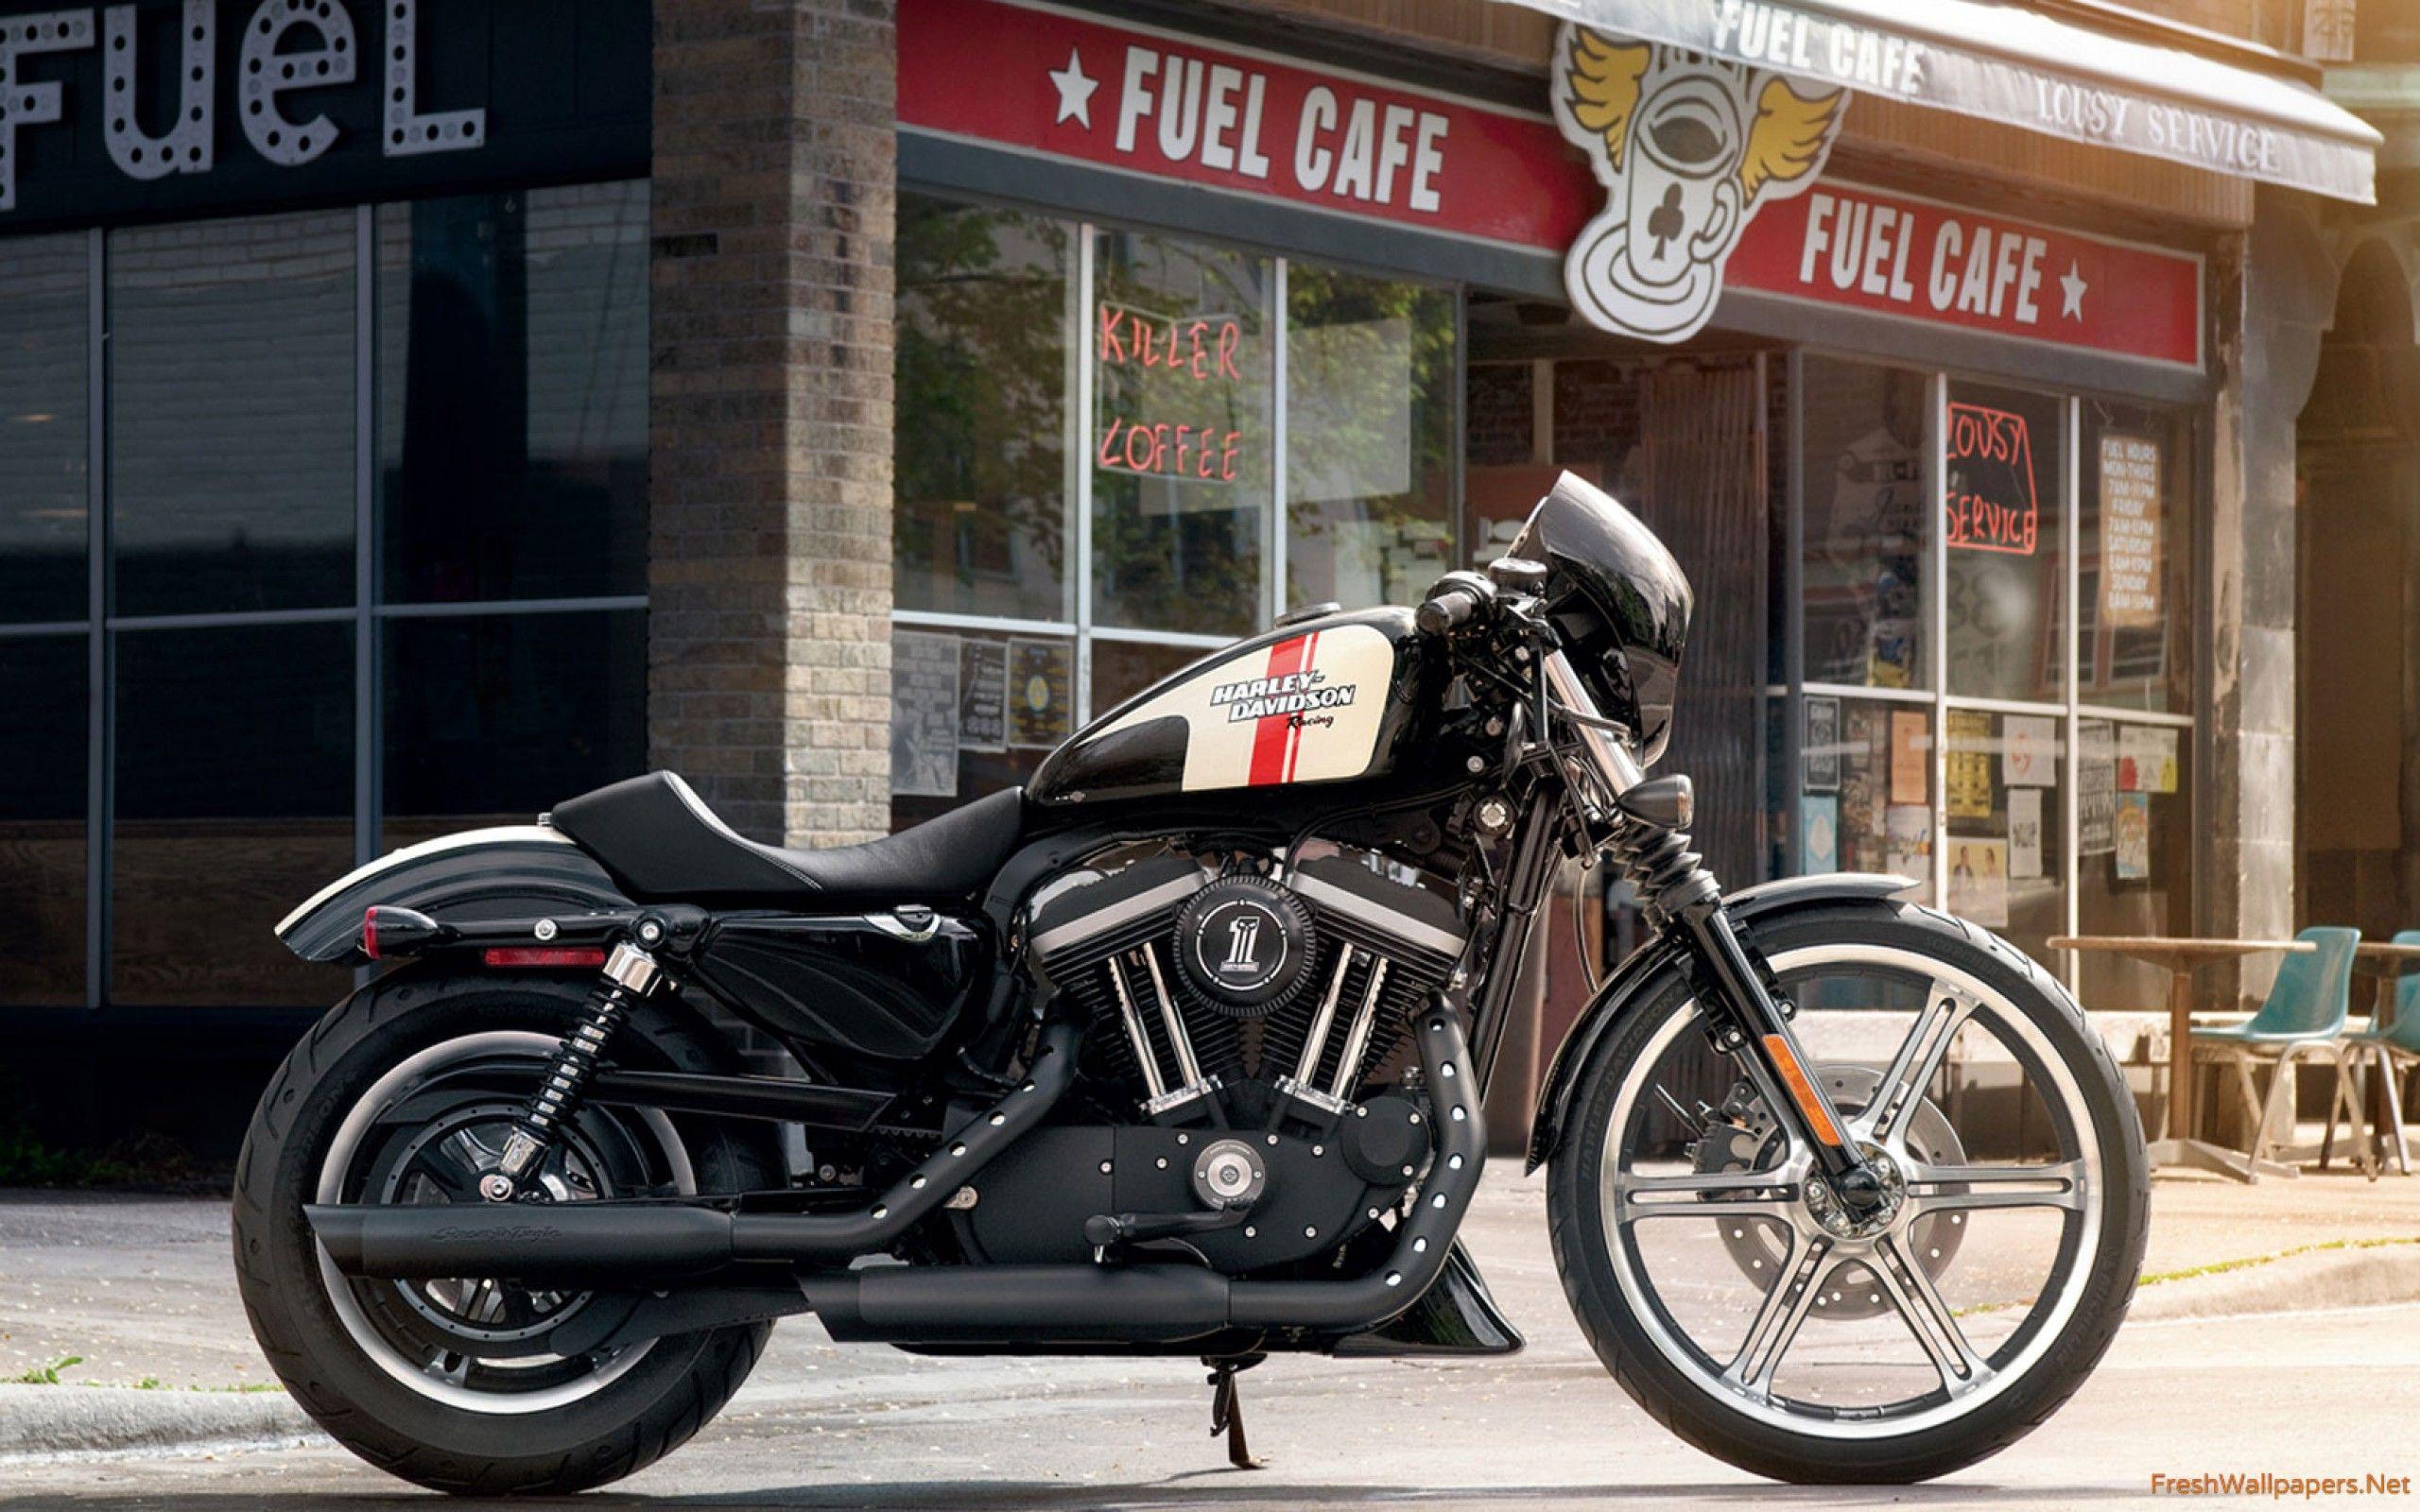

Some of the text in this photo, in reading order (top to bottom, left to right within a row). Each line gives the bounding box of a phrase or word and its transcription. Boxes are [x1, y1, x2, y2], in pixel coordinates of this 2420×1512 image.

[1713, 0, 1926, 94] FUEL CAFE
[1115, 45, 1449, 213] FUEL CAFE
[2034, 76, 2280, 173] LOUSY SERVICE
[1800, 193, 2047, 325] FUEL CAFE
[1099, 305, 1240, 381] KILLER
[1229, 684, 1356, 723] DAVIDSON
[1287, 714, 1335, 730] Racing
